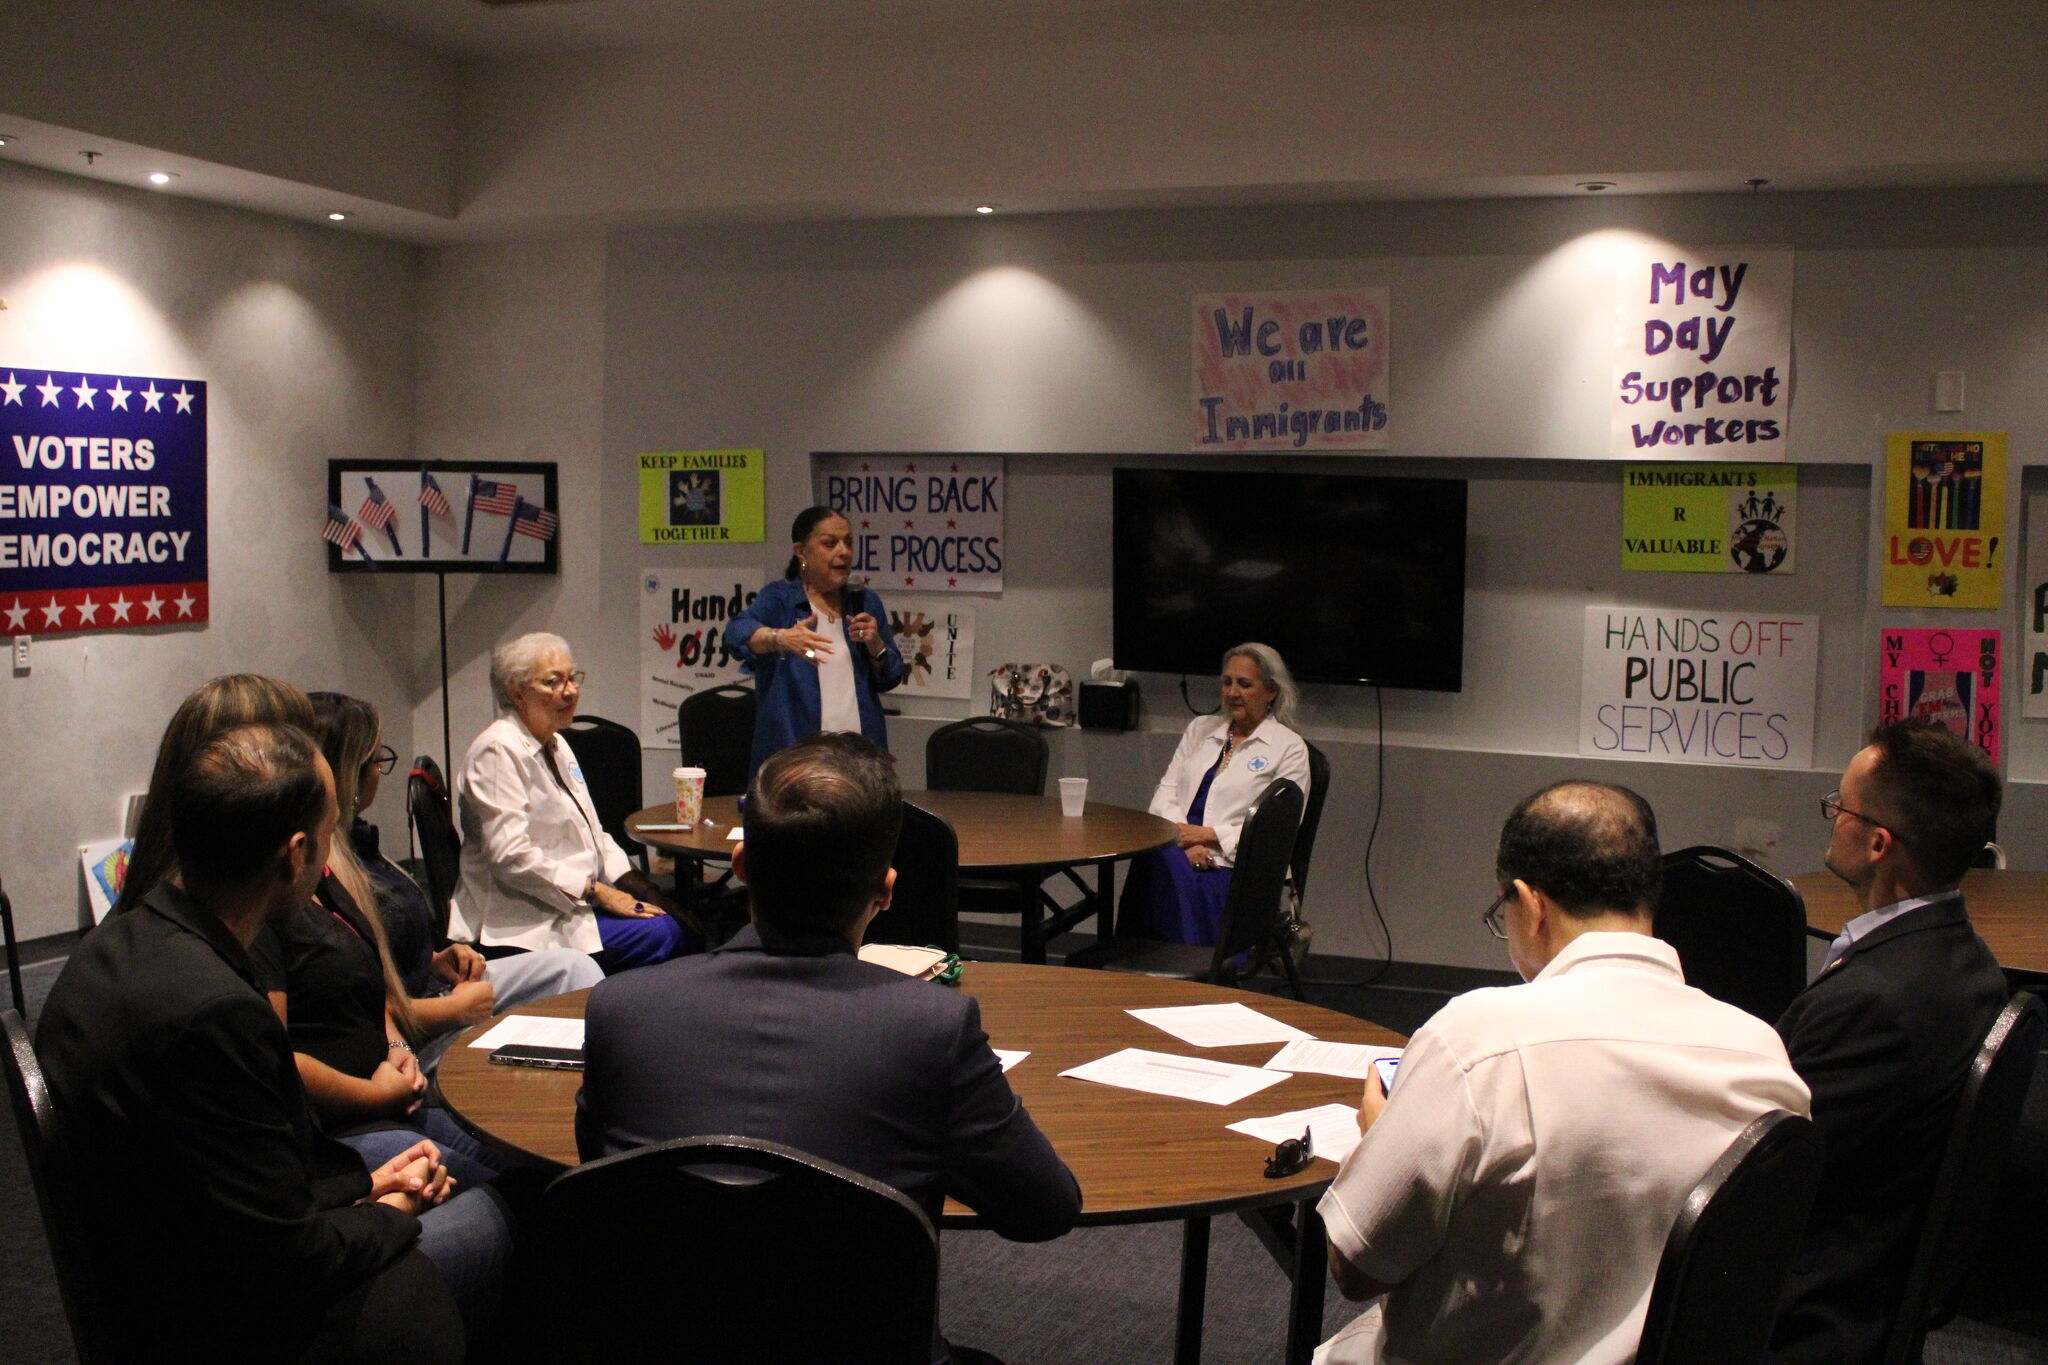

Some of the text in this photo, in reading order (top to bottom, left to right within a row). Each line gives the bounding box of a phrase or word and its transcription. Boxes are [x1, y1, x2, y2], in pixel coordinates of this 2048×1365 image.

[1649, 262, 1748, 312] May
[1214, 306, 1369, 358] We are
[1644, 315, 1736, 364] Day
[1619, 366, 1780, 413] Support
[12, 435, 156, 471] VOTERS
[640, 454, 747, 469] KEEP FAMILIES
[828, 475, 998, 513] BRING BACK
[1629, 471, 1758, 487] IMMIGRANTS
[0, 485, 171, 518] EMPOWER
[1673, 507, 1686, 522] R
[0, 531, 191, 568] EMOCRACY
[651, 527, 730, 541] TOGETHER
[1625, 538, 1721, 555] VALUABLE
[1890, 535, 1999, 569] LOVE!
[851, 535, 1002, 573] UE PROCESS
[946, 614, 957, 680] UNITE
[1605, 614, 1803, 657] HANDS OFF
[1625, 656, 1756, 705] PUBLIC
[1884, 635, 1903, 727] MY CHO
[1593, 704, 1789, 761] SERVICES
[1978, 703, 1994, 755] YOU
